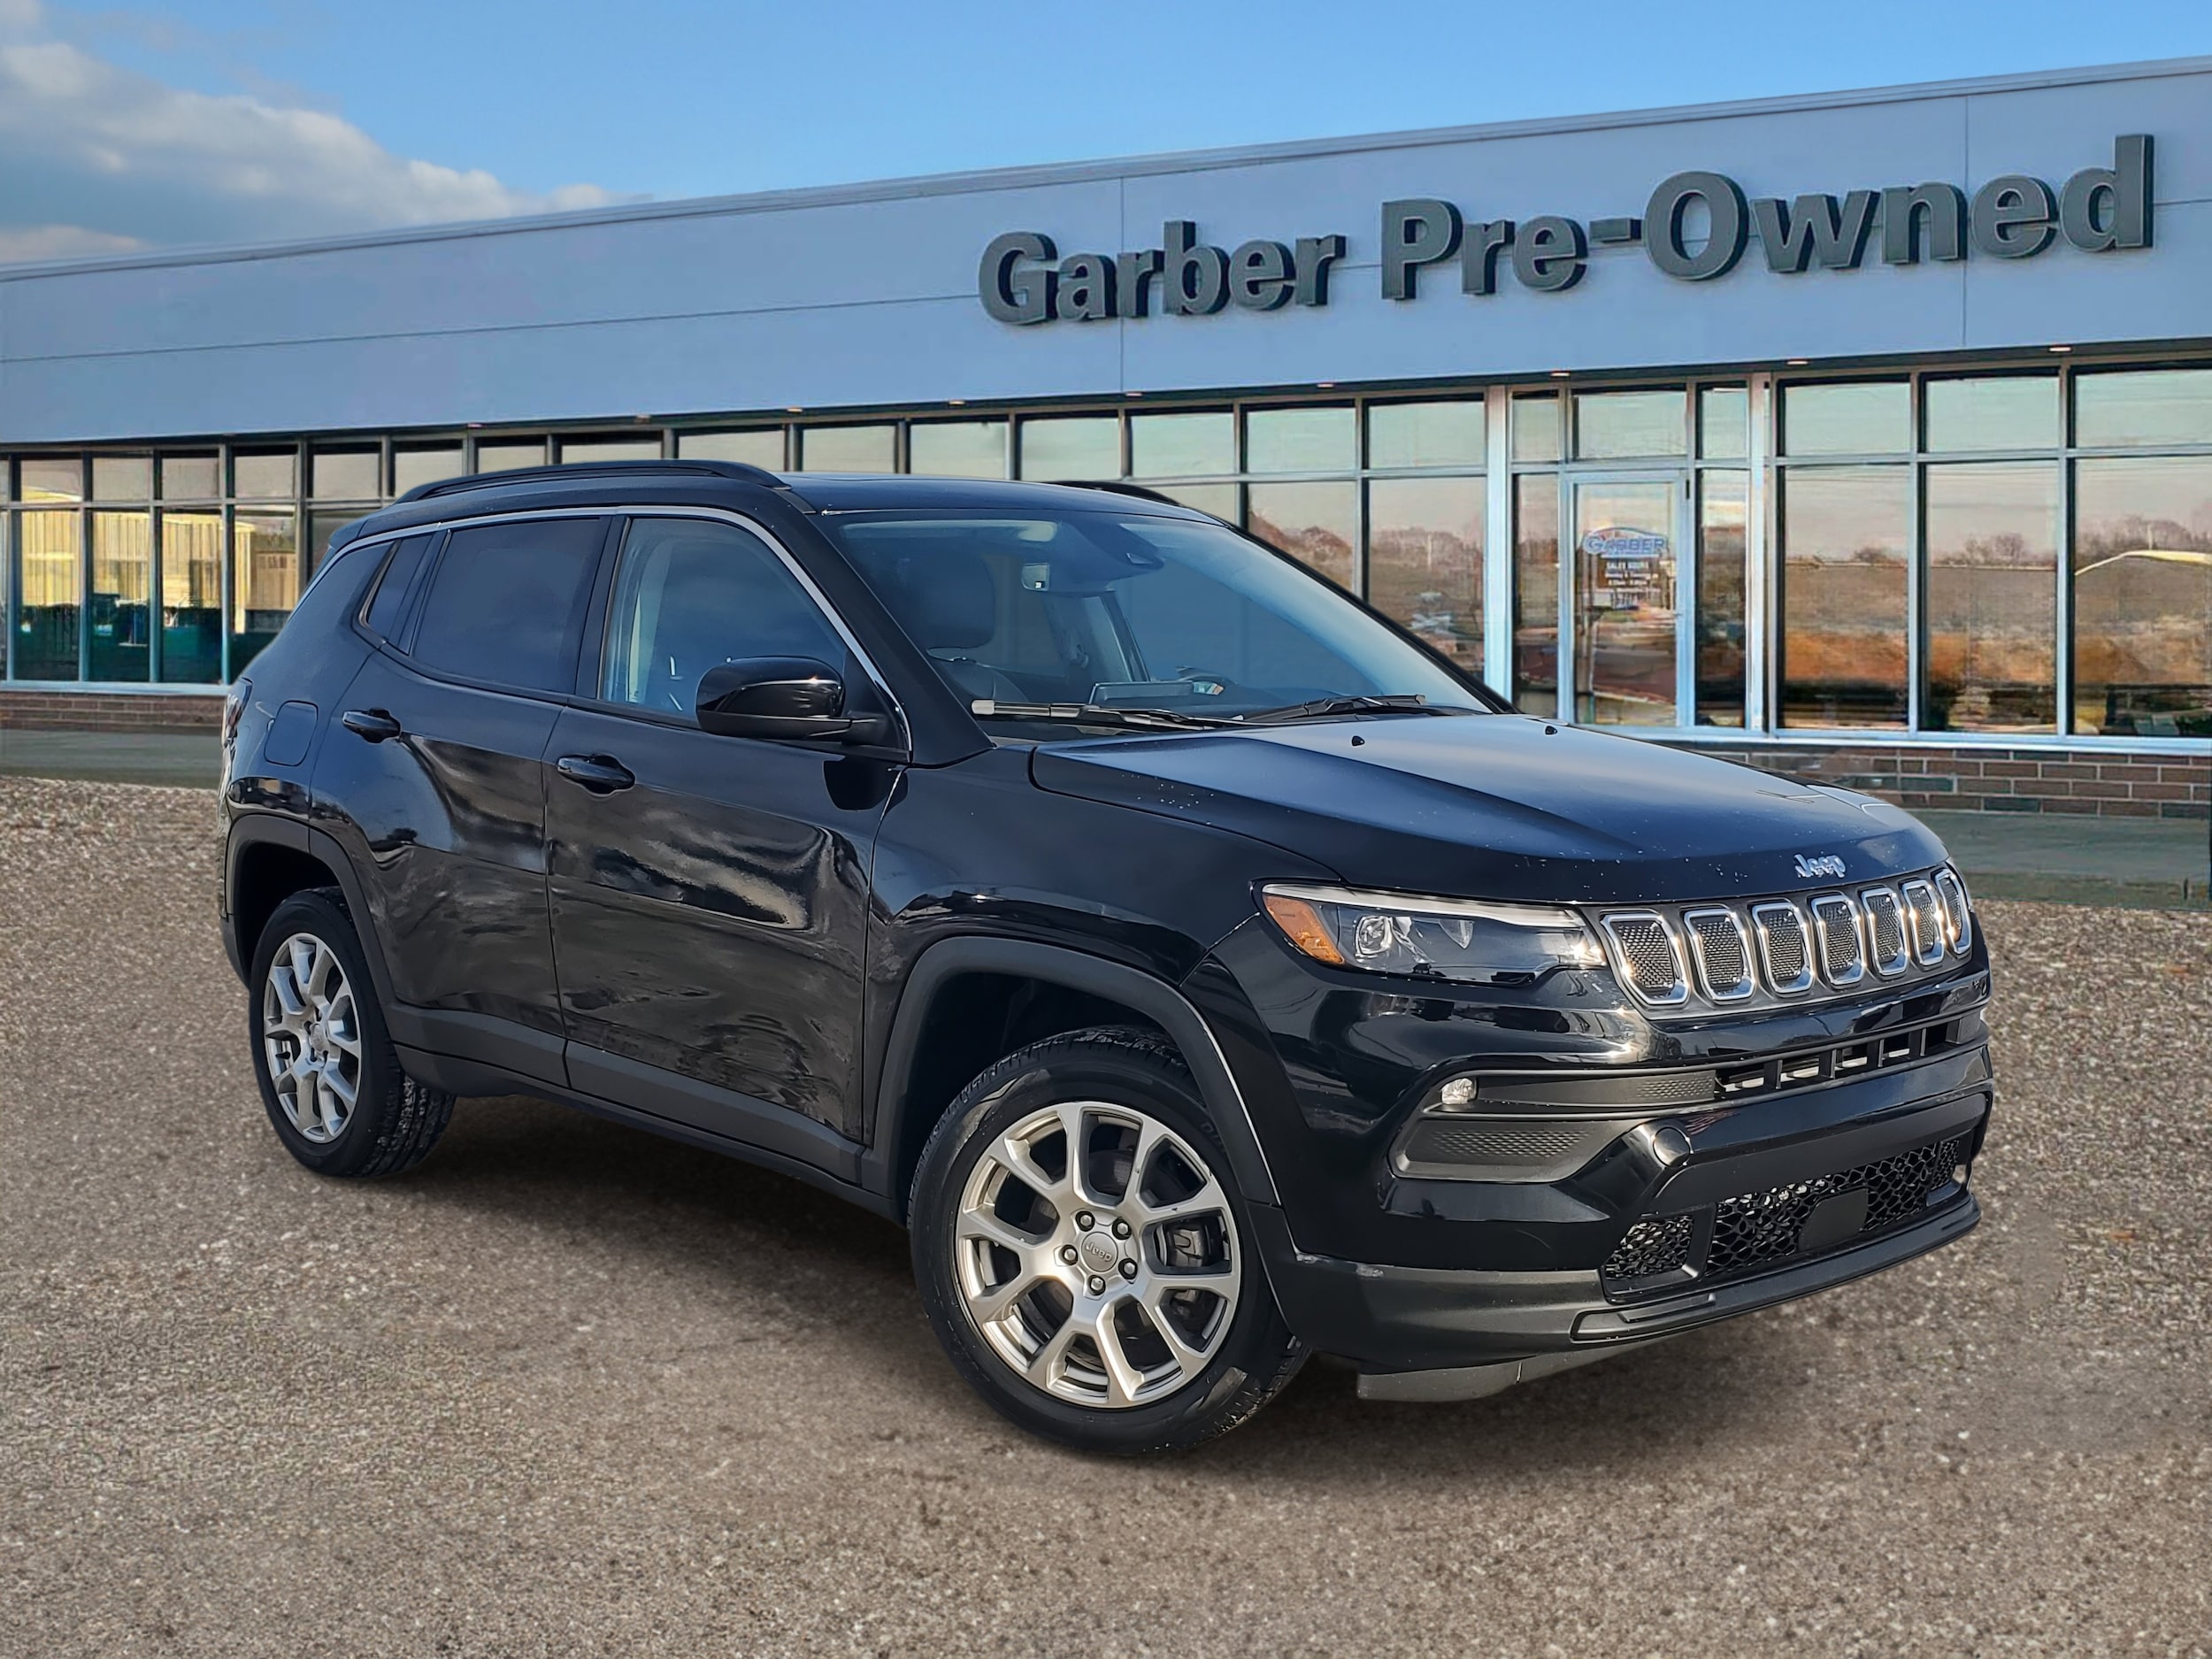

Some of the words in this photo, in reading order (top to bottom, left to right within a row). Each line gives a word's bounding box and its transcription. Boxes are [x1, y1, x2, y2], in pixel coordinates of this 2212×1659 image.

[979, 221, 1346, 326] Garber
[1381, 133, 2154, 301] Pre-Owned
[1793, 854, 1846, 878] Jeep
[1085, 1241, 1112, 1263] Jeep
